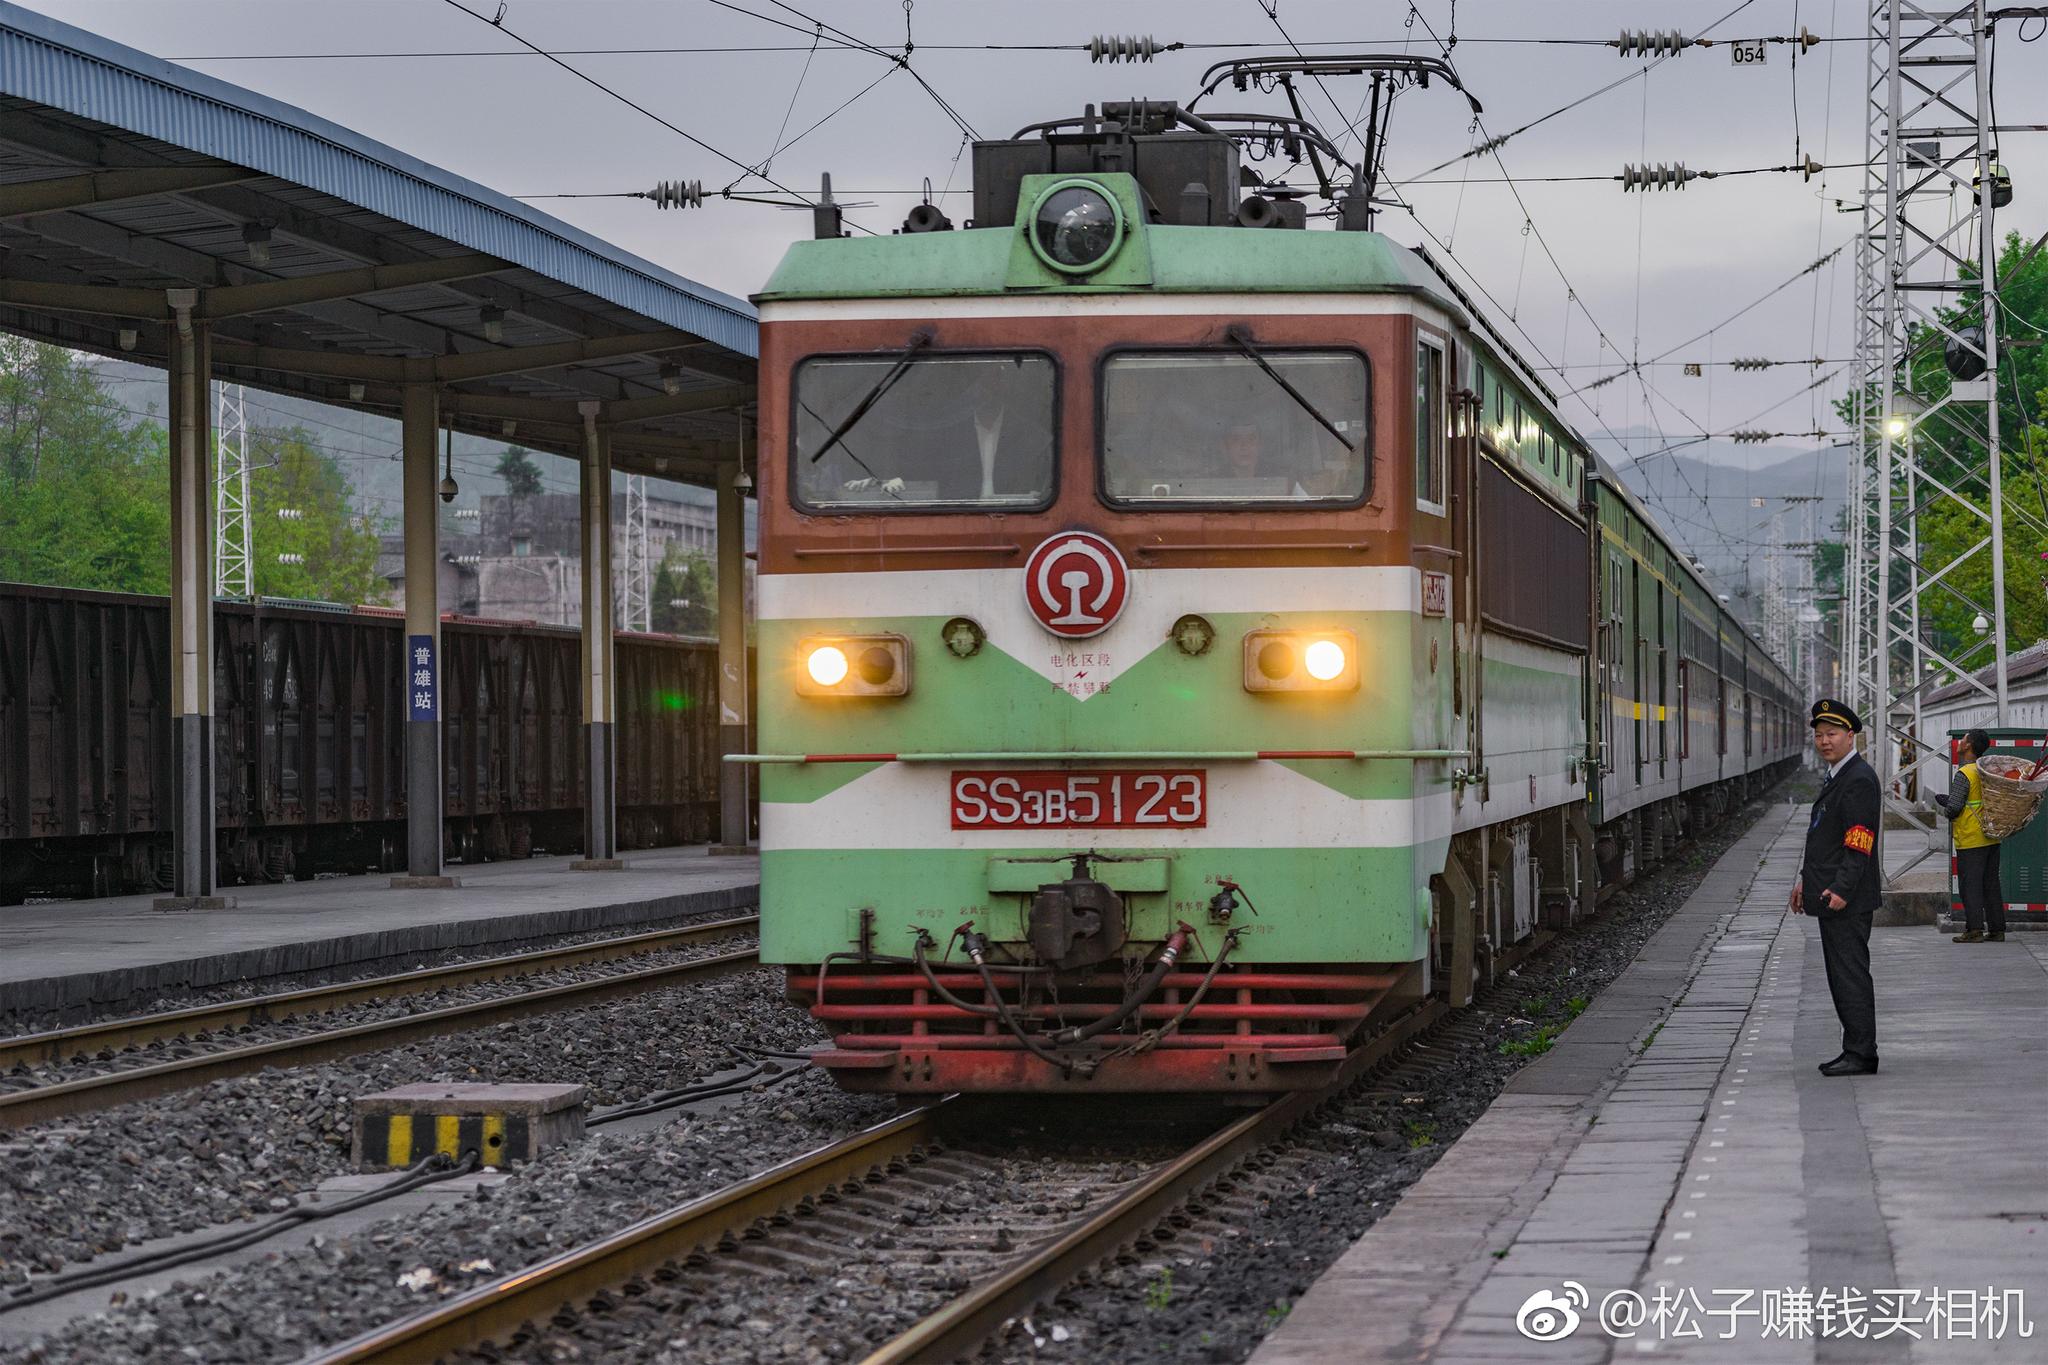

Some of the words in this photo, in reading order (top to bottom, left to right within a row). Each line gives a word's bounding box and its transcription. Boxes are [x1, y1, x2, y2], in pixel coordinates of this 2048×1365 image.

[1734, 47, 1765, 63] 054
[1051, 653, 1111, 668] 电化区段
[414, 647, 432, 710] 普雄站
[955, 774, 1202, 825] SS3B5123
